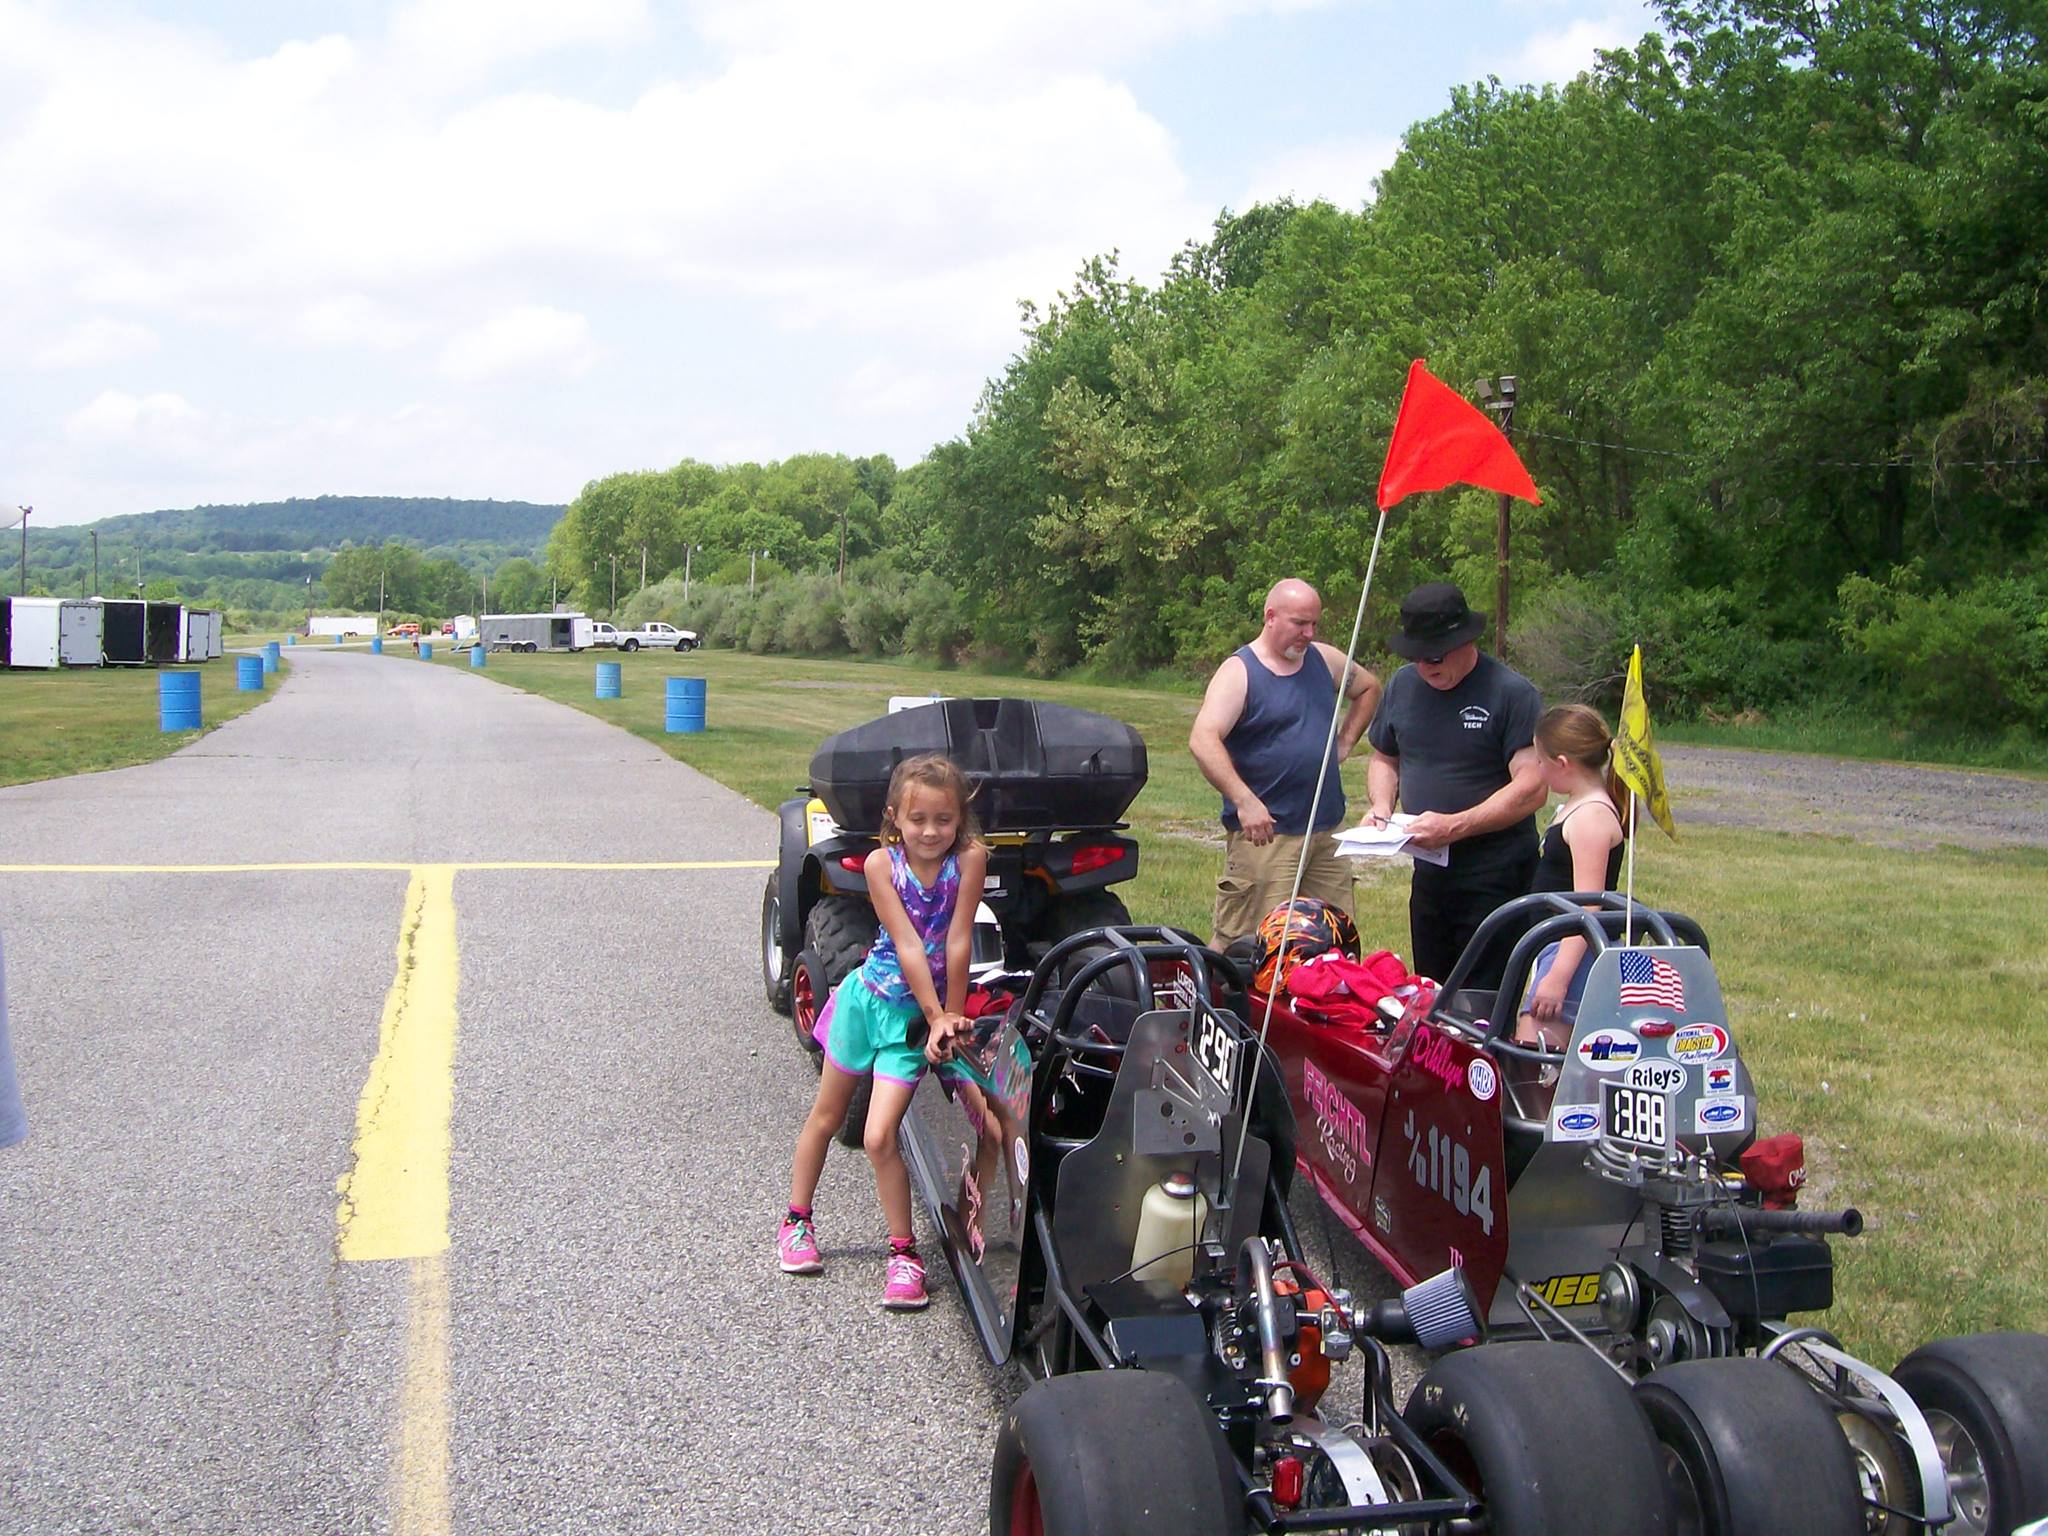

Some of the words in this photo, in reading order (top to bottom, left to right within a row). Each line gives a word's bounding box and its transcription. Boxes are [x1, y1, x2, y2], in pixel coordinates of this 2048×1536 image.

[1463, 721, 1483, 729] TECH
[1674, 1034, 1714, 1053] DRAGSTER
[1471, 1065, 1493, 1094] NHRA
[1303, 1056, 1372, 1168] FEICHTL
[1316, 1115, 1357, 1185] Racing
